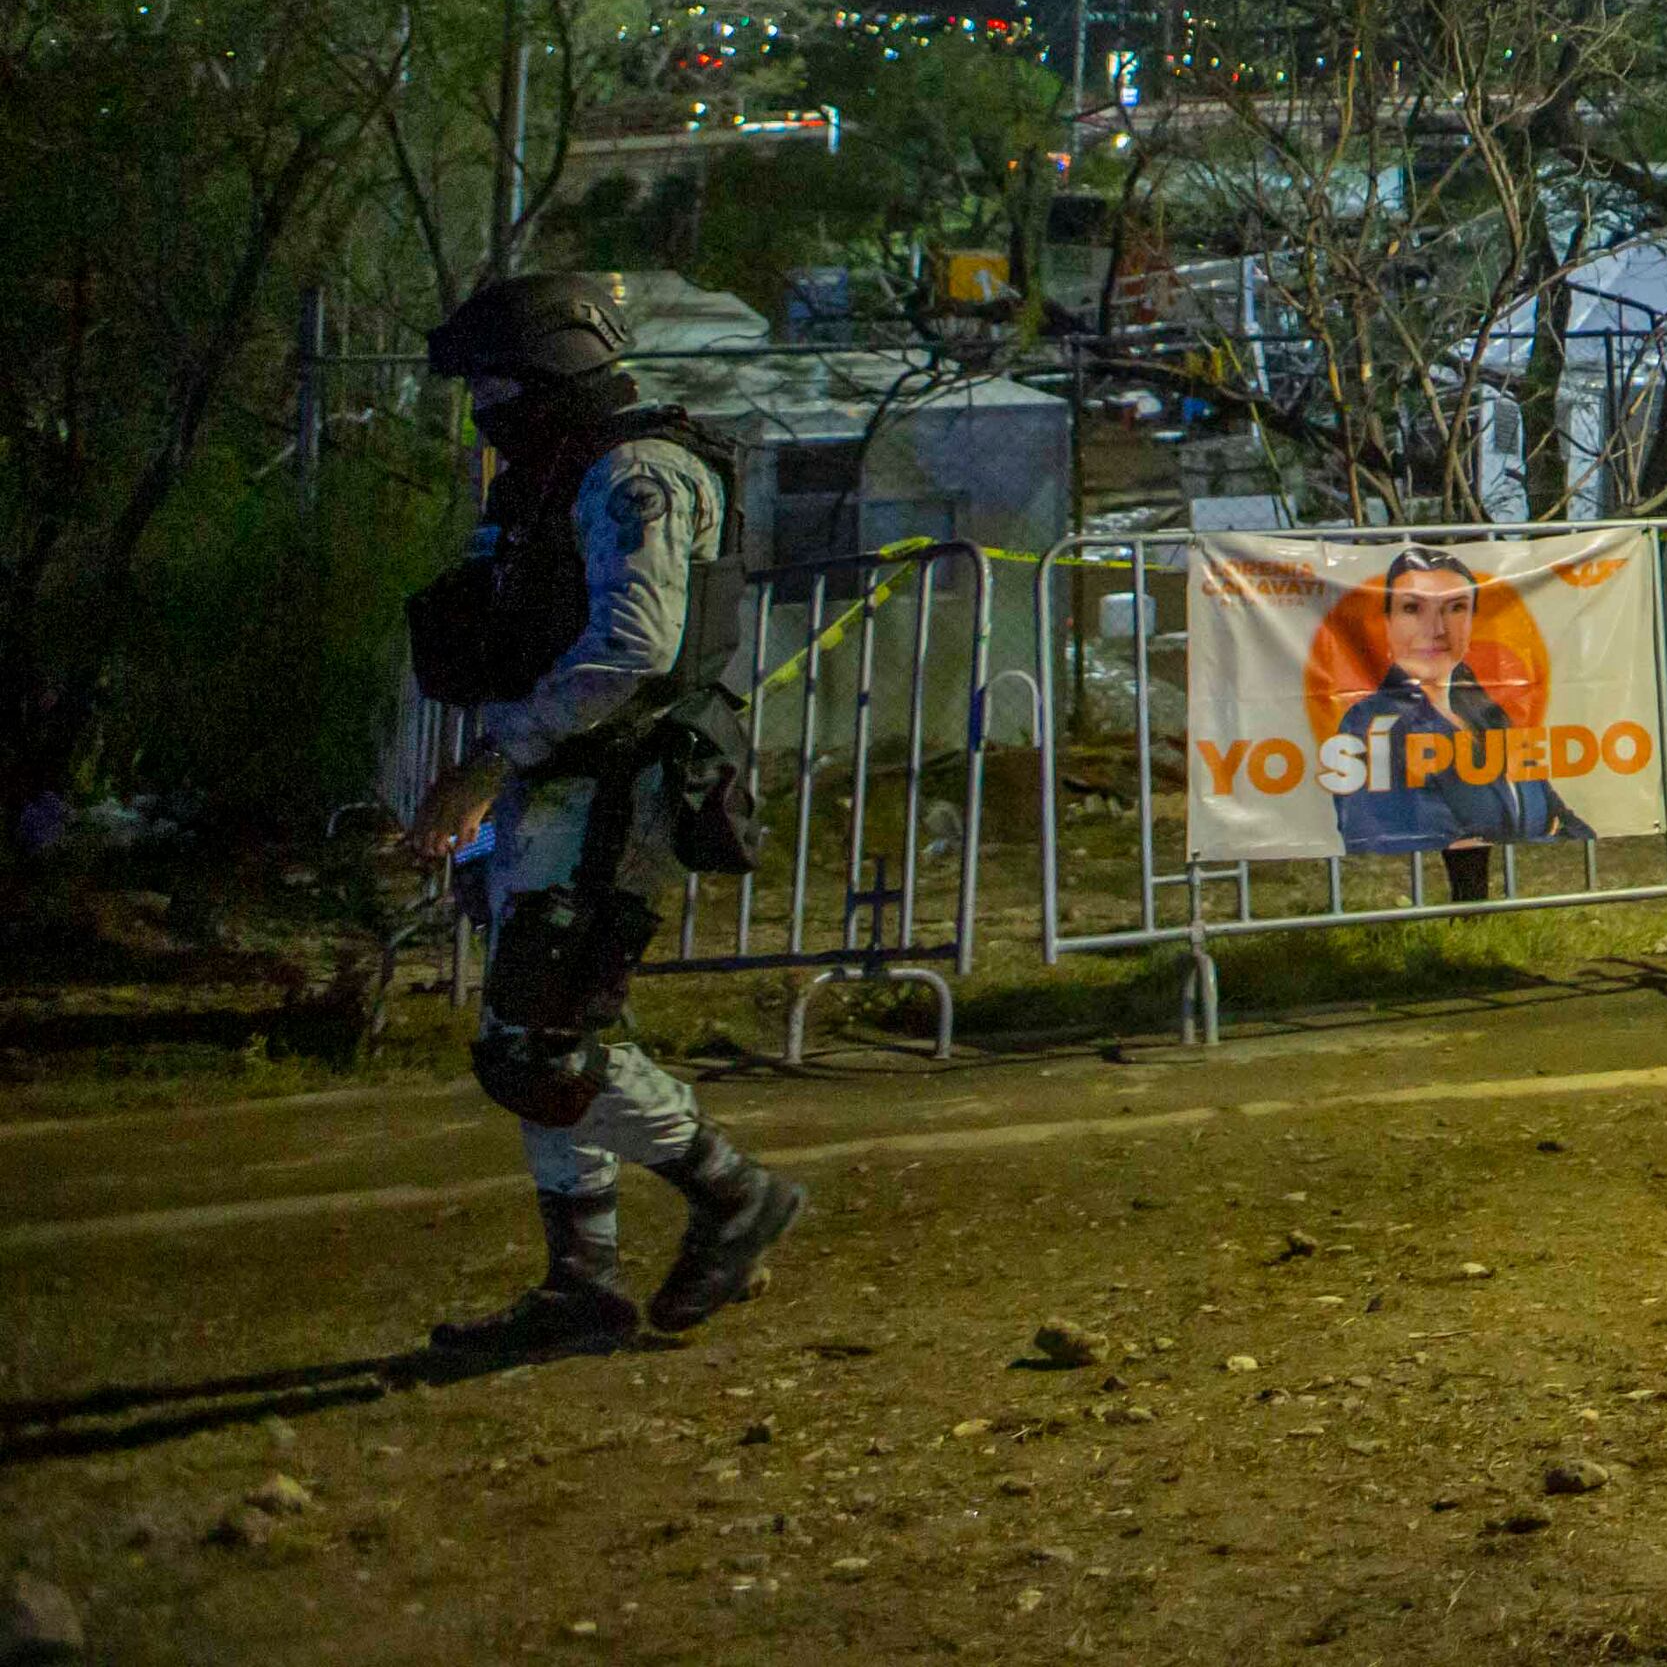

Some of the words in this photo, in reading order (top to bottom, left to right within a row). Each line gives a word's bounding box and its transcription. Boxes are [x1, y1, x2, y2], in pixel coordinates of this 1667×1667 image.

[1196, 737, 1305, 796] YO
[1316, 713, 1401, 795] SÍ
[1406, 720, 1653, 789] PUEDO
